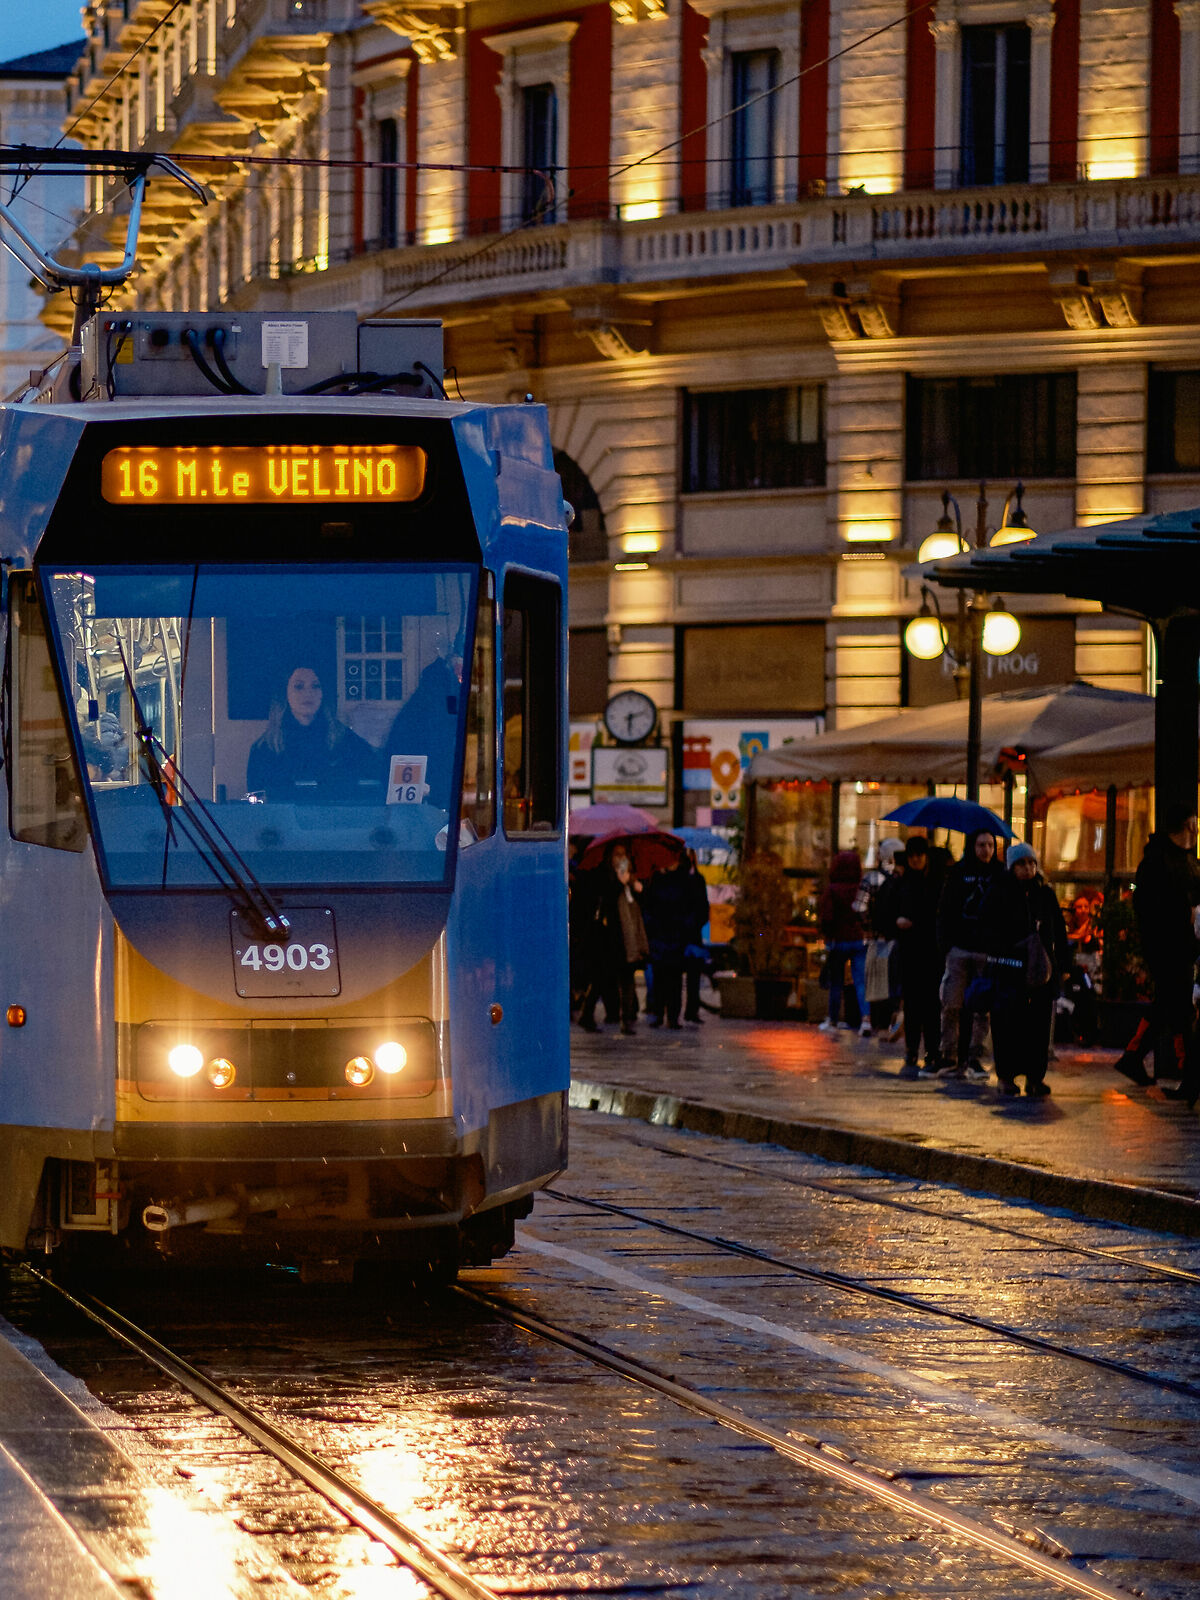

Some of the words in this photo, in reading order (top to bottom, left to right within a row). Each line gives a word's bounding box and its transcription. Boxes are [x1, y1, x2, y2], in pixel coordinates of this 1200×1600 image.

[119, 458, 159, 497] 16
[176, 458, 250, 497] M.te
[268, 457, 397, 496] VELINO
[402, 766, 413, 784] 6
[395, 786, 417, 801] 16
[240, 943, 332, 972] 4903
